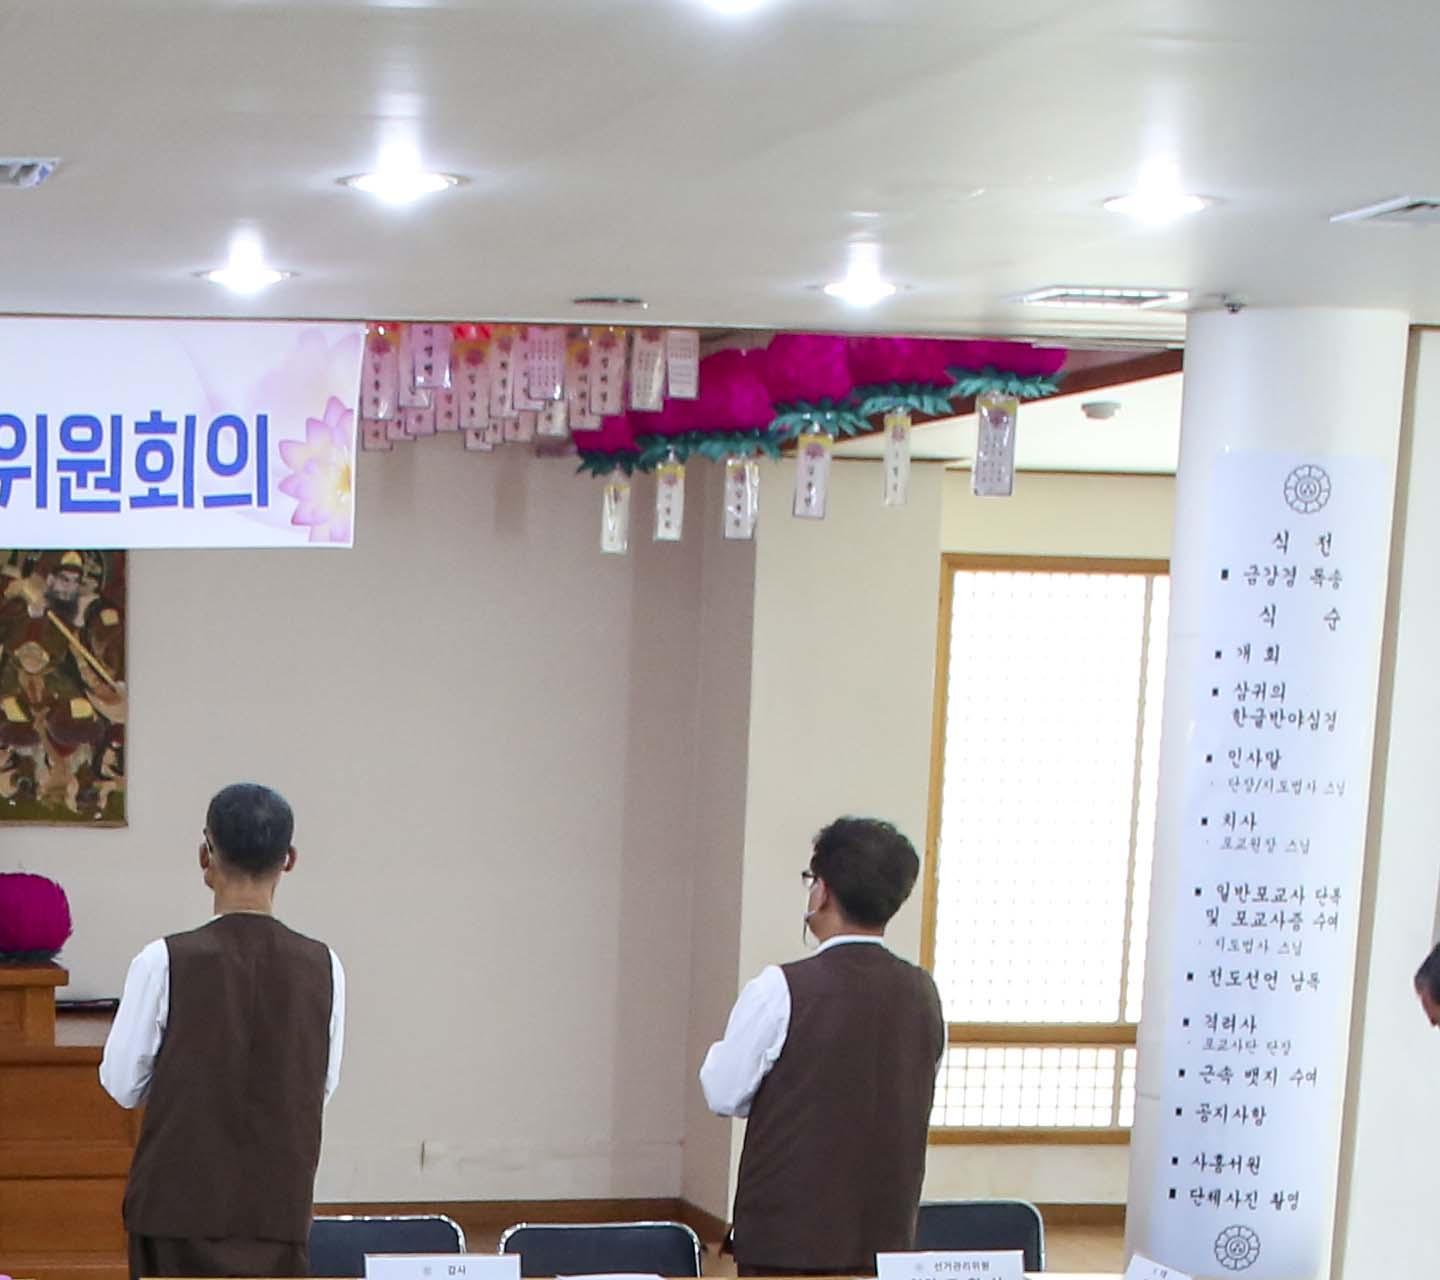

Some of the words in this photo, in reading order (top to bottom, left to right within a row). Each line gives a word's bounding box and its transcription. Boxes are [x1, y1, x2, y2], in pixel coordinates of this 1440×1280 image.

[1273, 530, 1289, 555] 식
[1244, 564, 1296, 588] 금강경
[1310, 568, 1342, 589] 독송
[1260, 603, 1276, 628] 식
[1324, 608, 1340, 631] 순
[1235, 681, 1286, 702] 삼귀의
[1233, 706, 1337, 731] 한글반야심경
[1228, 748, 1282, 770] 인사말
[1224, 811, 1256, 831] 치사
[1217, 881, 1305, 905] 일반포교사
[1206, 906, 1219, 927] 및
[1231, 909, 1304, 931] 포교사증
[1313, 912, 1339, 932] 수여
[1209, 966, 1278, 991] 전도선언
[1292, 971, 1320, 992] 낭독
[1205, 1013, 1256, 1033] 격려사
[1199, 1065, 1233, 1085] 근속
[1245, 1067, 1278, 1087] 뱃지
[1290, 1068, 1317, 1087] 수여
[1196, 1103, 1266, 1126] 공지사항
[1193, 1152, 1261, 1175] 사홍서원
[1190, 1186, 1258, 1210] 단체사진
